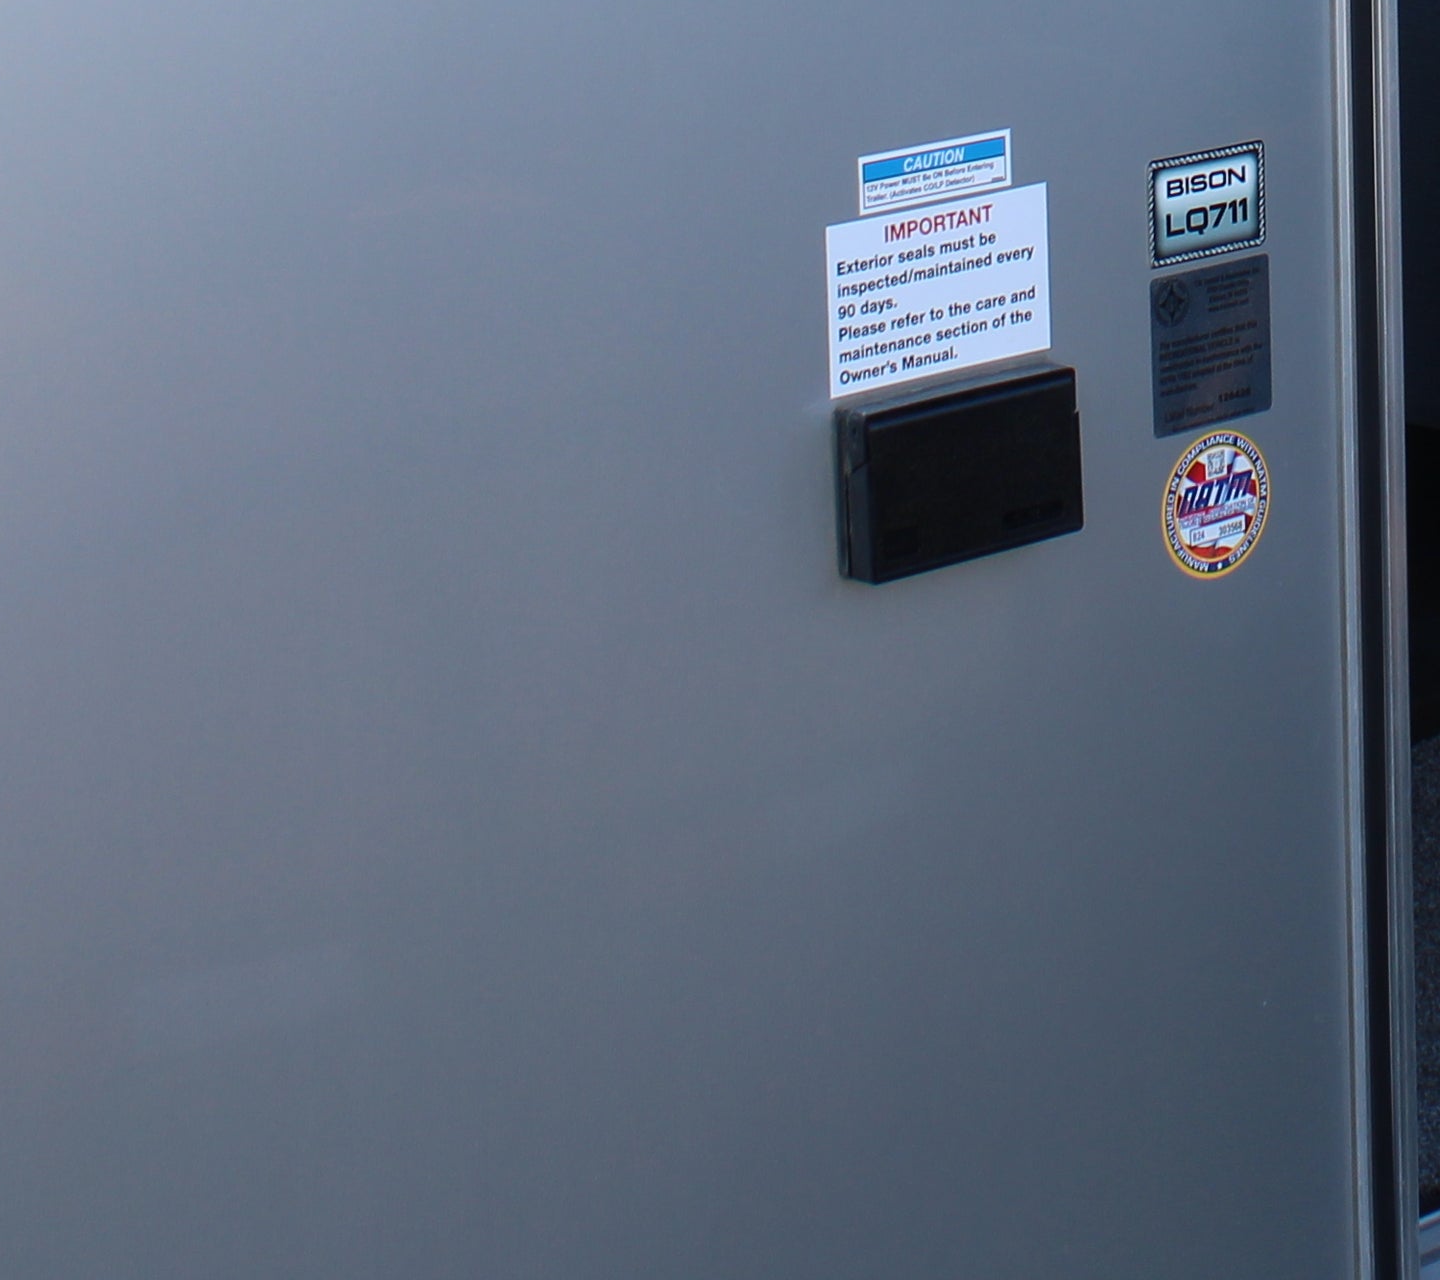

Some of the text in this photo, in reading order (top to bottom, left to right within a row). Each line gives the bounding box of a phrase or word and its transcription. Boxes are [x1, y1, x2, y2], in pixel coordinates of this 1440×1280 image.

[879, 180, 900, 191] Power
[902, 175, 921, 185] MUST
[922, 172, 931, 181] Be
[932, 169, 943, 179] ON
[944, 166, 966, 178] Before
[967, 161, 994, 174] Entering
[903, 146, 965, 172] CAUTION
[945, 175, 975, 188] Detector)
[1166, 165, 1246, 198] BISON
[884, 204, 993, 243] IMPORTANT
[1166, 197, 1248, 237] LQ711
[836, 232, 997, 276] Exterior seals must be
[837, 246, 1034, 298] inspected/maintained every
[838, 297, 898, 319] 90 days.
[838, 285, 1035, 342] Please refer to the care and
[839, 309, 1033, 364] maintenance section of the
[839, 346, 959, 385] Owner's Manual.
[1177, 434, 1235, 475] COMPLIANCE
[1236, 437, 1258, 460] WITH
[1171, 474, 1180, 492] IN
[1255, 460, 1267, 496] NATM
[1167, 493, 1210, 572] MANUFACTURED
[1228, 500, 1268, 564] GUIDELINES
